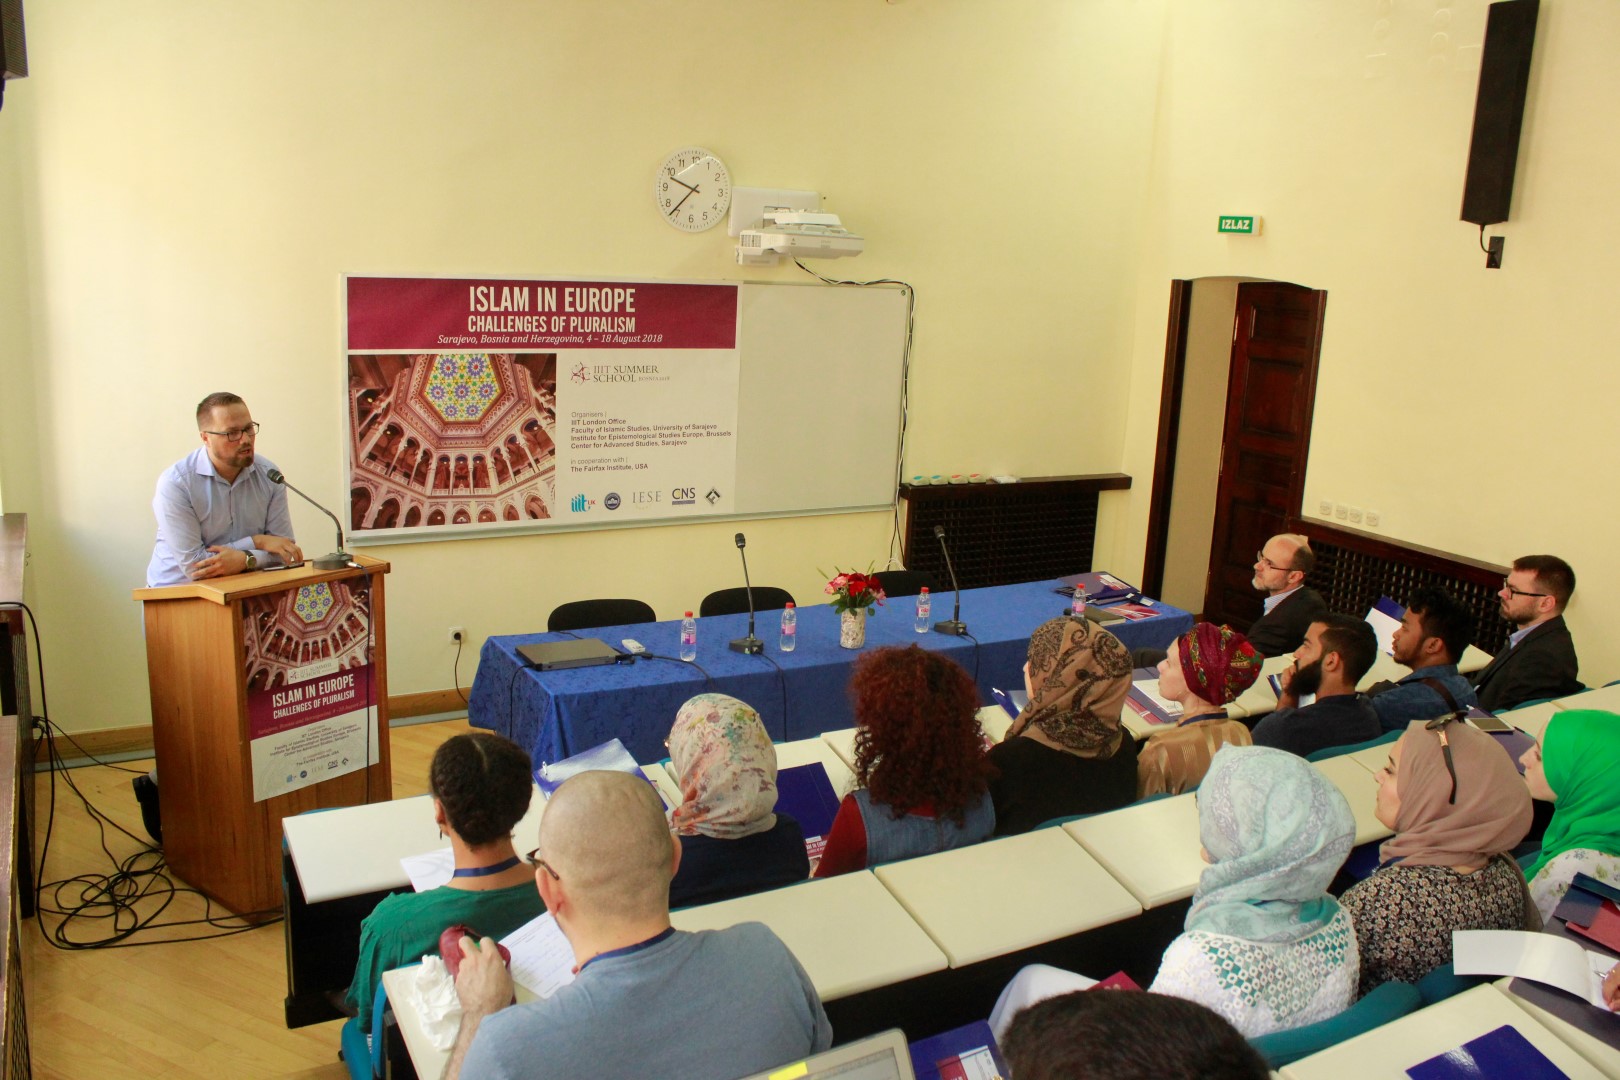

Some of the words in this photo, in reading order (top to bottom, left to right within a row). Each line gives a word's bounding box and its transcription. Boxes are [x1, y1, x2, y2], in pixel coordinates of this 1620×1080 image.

[678, 159, 685, 168] 11
[706, 162, 710, 170] 1
[668, 168, 676, 176] 10
[714, 173, 720, 182] 2
[662, 182, 668, 192] 9
[718, 188, 724, 198] 3
[666, 199, 672, 208] 8
[712, 202, 718, 211] 4
[674, 209, 680, 218] 7
[702, 212, 708, 220] 5
[688, 214, 694, 223] 6
[1222, 219, 1250, 230] IZLAZ
[469, 286, 529, 312] ISLAM
[537, 286, 557, 312] IN
[564, 287, 636, 313] EUROPE
[468, 315, 548, 333] CHALLENGES
[551, 316, 567, 333] OF
[570, 316, 636, 334] PLURALISM
[437, 334, 478, 346] Sarajevo,
[480, 334, 510, 344] Bosnia
[511, 334, 529, 344] and
[530, 334, 584, 346] Herzegovina,
[586, 334, 592, 343] 4
[601, 334, 612, 343] 18
[612, 334, 640, 345] August
[642, 334, 664, 343] 2018
[593, 365, 612, 374] IIIT
[613, 365, 660, 374] SUMMER
[593, 374, 636, 383] SCHOOL
[608, 433, 657, 441] Epistemological
[632, 490, 662, 504] IESE
[672, 487, 696, 500] CNS
[272, 687, 302, 708] ISLAM
[306, 684, 316, 699] IN
[319, 674, 354, 696] EUROPE
[273, 701, 312, 720] CHALLENGES
[314, 698, 321, 708] OF
[322, 690, 354, 706] PLURALISM
